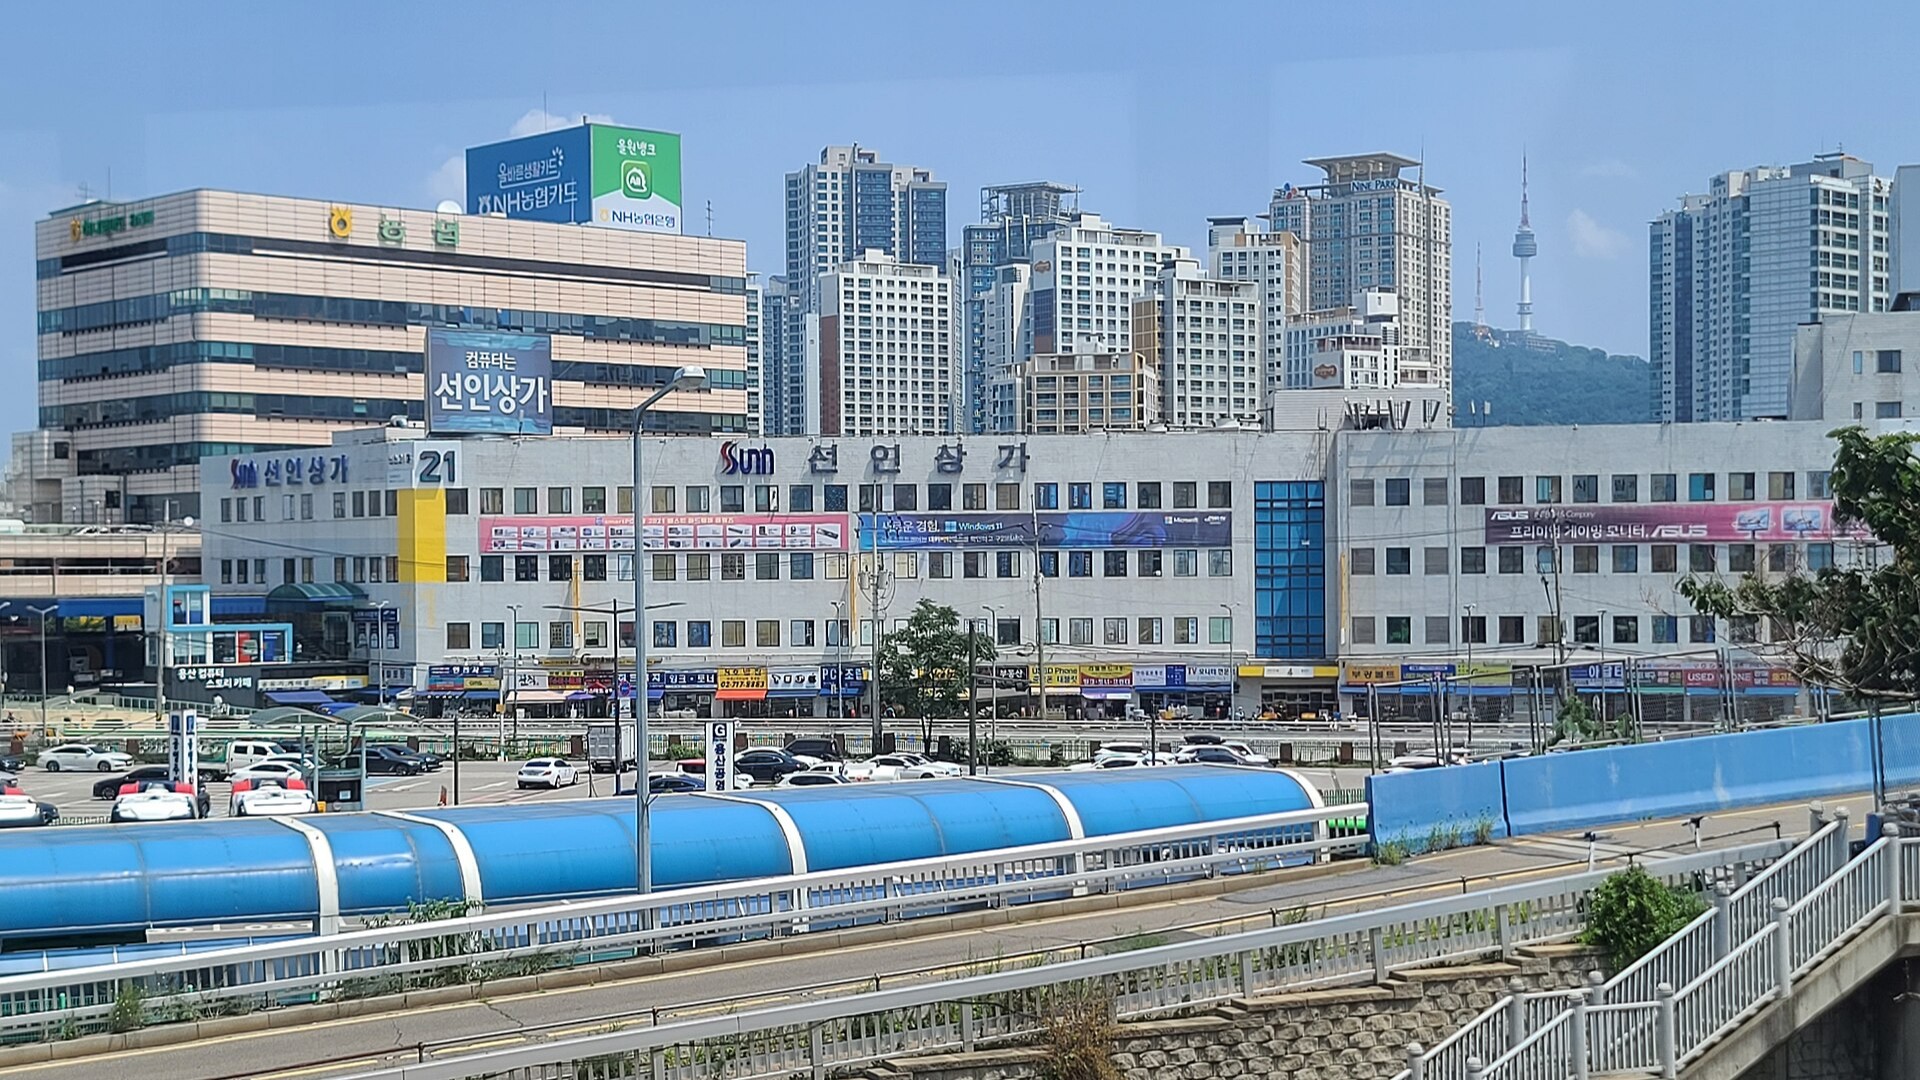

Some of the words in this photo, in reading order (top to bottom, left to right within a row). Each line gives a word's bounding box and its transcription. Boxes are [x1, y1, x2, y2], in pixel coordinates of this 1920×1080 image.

[1375, 178, 1397, 190] PARK
[611, 209, 675, 228] NH농협은행
[465, 350, 517, 371] 컴퓨터는
[433, 372, 548, 414] 선인상가
[808, 443, 1030, 474] 선인상가
[263, 454, 348, 486] 선인상가
[418, 450, 456, 483] 21
[1490, 510, 1529, 520] ASUS
[958, 522, 995, 530] Windows
[1509, 525, 1561, 539] 프리미엄
[1564, 525, 1602, 538] 게이밍
[1651, 524, 1708, 538] ASUS
[178, 668, 197, 680] 용산
[198, 667, 224, 679] 컴퓨터
[822, 667, 837, 680] PC
[1000, 668, 1023, 678] 부동산
[1687, 672, 1715, 681] USED
[205, 677, 232, 689] 스토리
[233, 676, 252, 688] 카페
[715, 725, 726, 736] G
